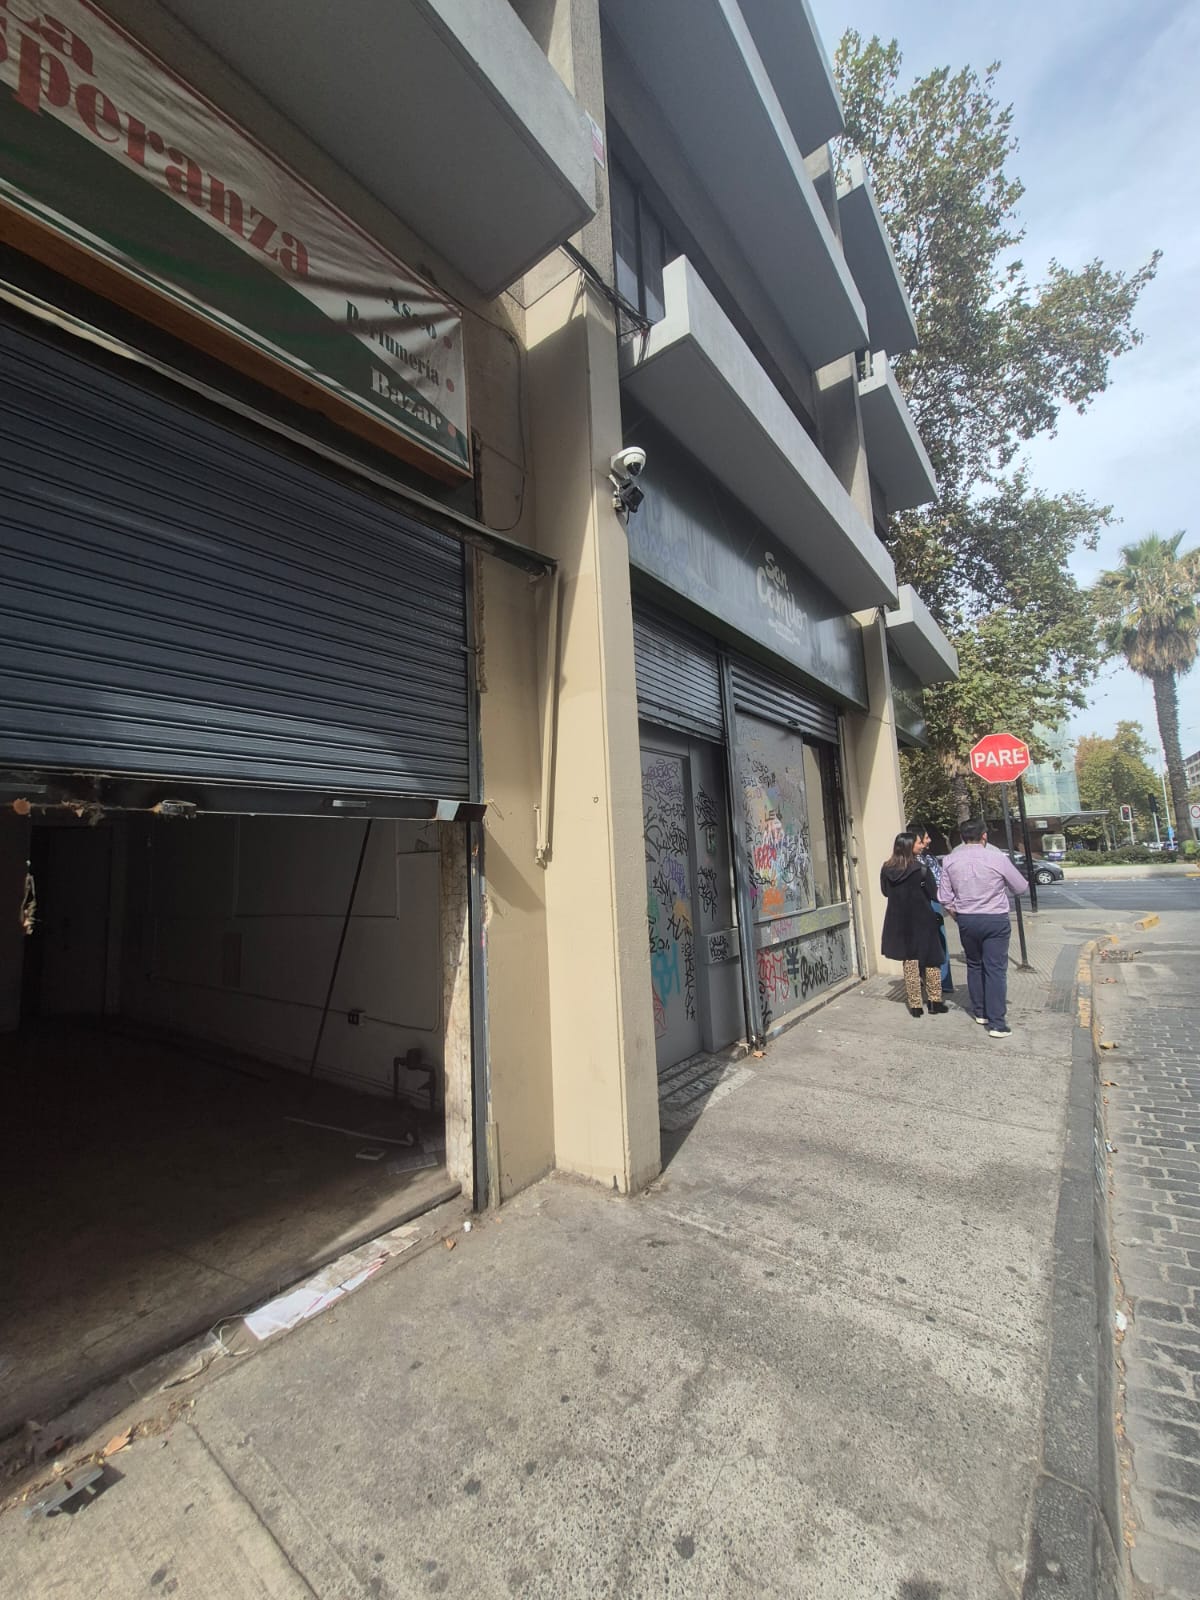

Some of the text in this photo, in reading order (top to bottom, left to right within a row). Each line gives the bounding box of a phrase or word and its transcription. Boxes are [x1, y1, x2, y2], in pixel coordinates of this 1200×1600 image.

[0, 16, 309, 275] peranza
[370, 366, 442, 431] Bazar
[974, 748, 1026, 769] PARE
